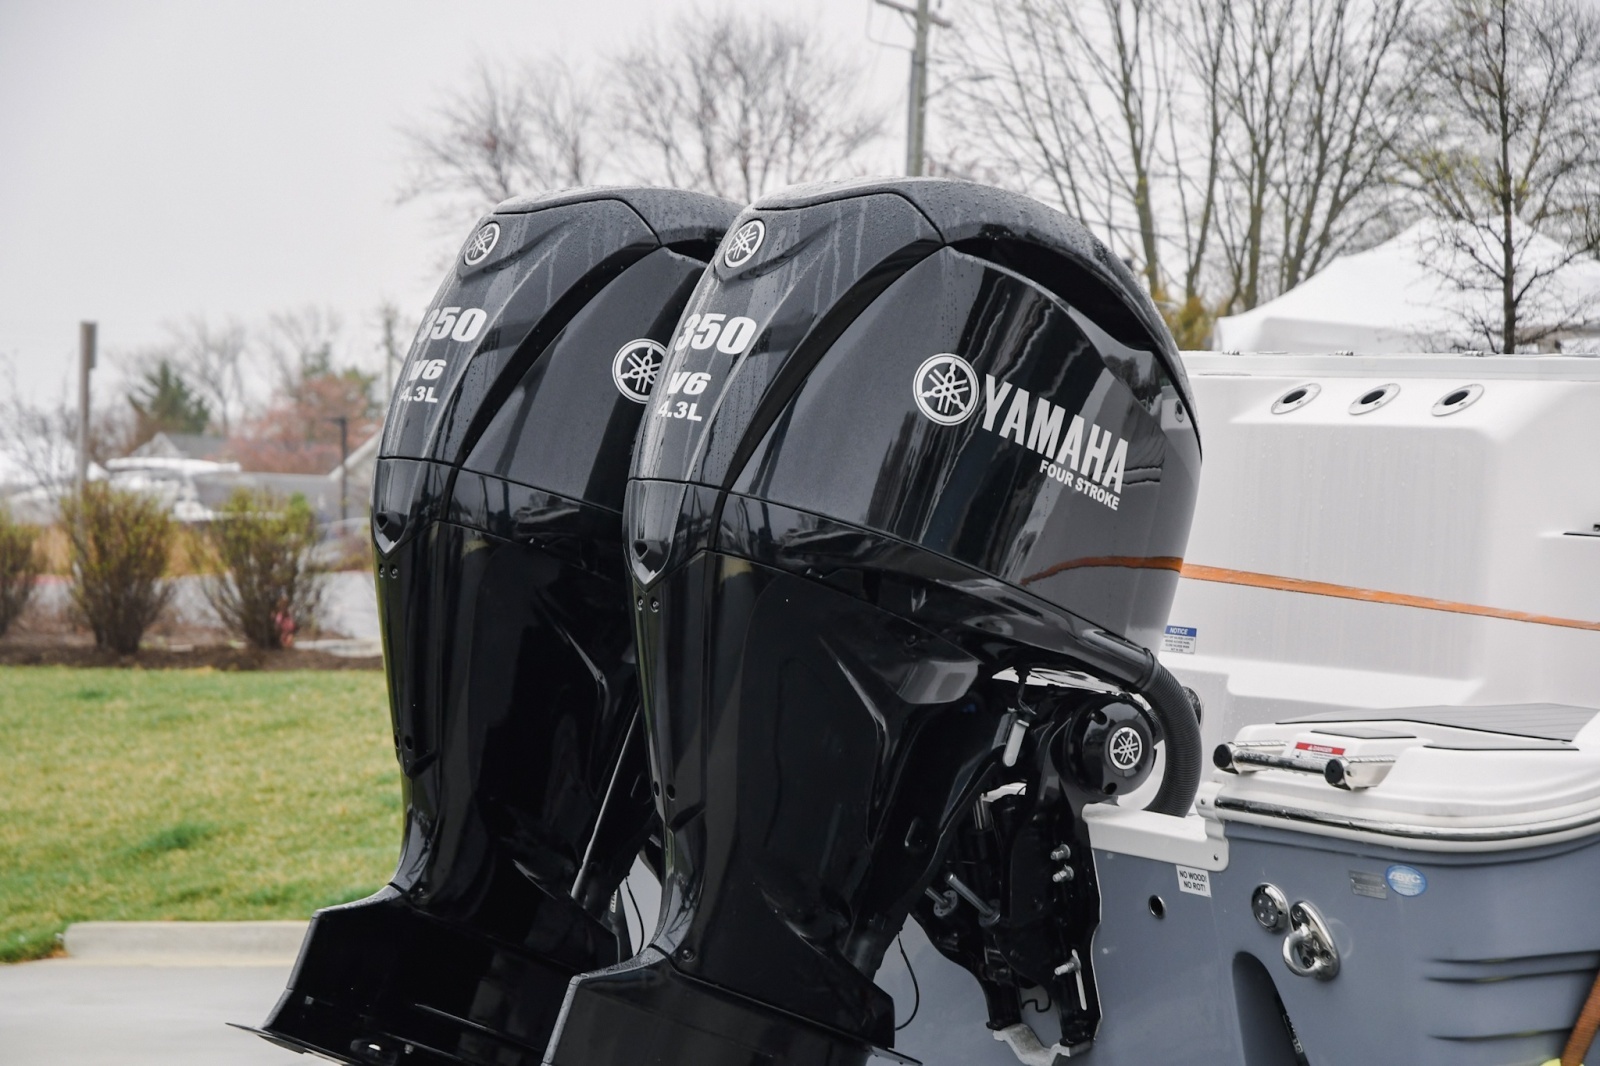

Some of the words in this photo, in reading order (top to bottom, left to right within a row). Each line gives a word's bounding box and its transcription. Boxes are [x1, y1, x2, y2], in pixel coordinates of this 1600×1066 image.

[674, 313, 757, 355] 350
[408, 359, 447, 382] V6
[667, 371, 712, 395] V6
[401, 385, 439, 404] 4.3L
[658, 401, 703, 422] 4.3L
[982, 373, 1129, 494] YAMAHA
[1039, 459, 1074, 487] FOUR
[1075, 476, 1121, 511] STROKE
[1169, 627, 1188, 635] NOTICE
[1179, 871, 1188, 879] NO
[1188, 872, 1207, 883] WOOD!
[1183, 881, 1192, 889] NO
[1192, 882, 1206, 892] ROT!
